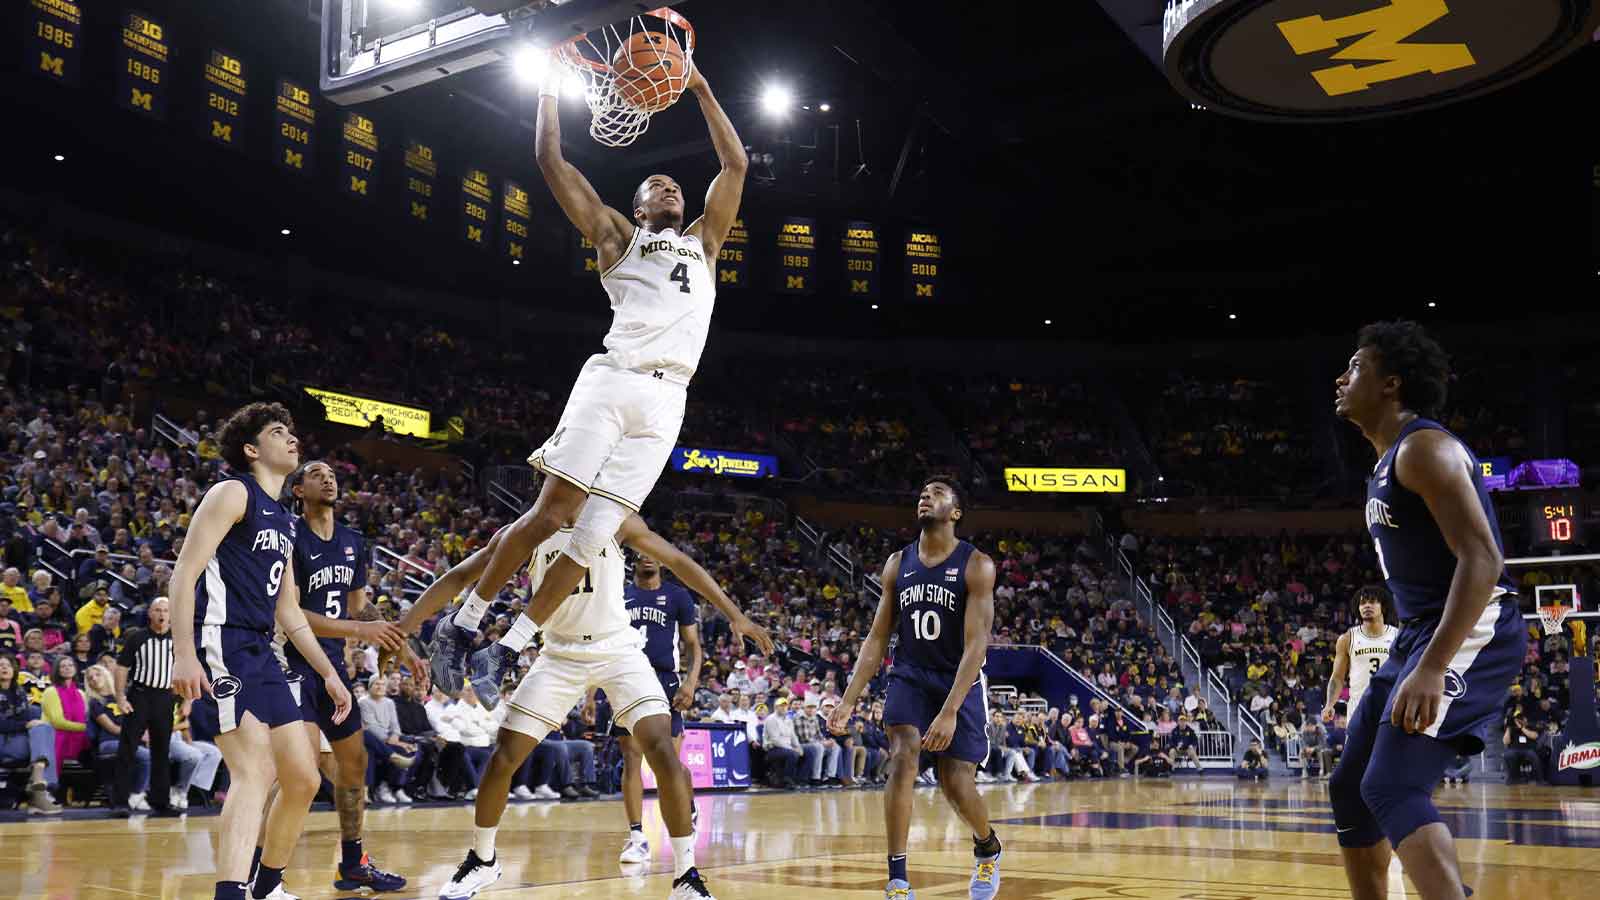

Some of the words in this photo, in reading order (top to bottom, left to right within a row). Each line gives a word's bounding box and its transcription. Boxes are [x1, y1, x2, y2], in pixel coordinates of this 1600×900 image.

[38, 22, 73, 48] 1985
[1276, 0, 1476, 96] M
[41, 52, 64, 77] M
[128, 59, 160, 84] 1986
[132, 88, 153, 111] M
[209, 93, 238, 116] 2012
[212, 120, 232, 142] M
[281, 123, 308, 144] 2014
[286, 149, 303, 168] M
[347, 151, 373, 171] 2017
[351, 176, 367, 195] M
[783, 224, 810, 234] NCAA
[847, 229, 873, 239] NCAA
[911, 233, 937, 243] NCAA
[784, 255, 808, 267] 1989
[848, 259, 872, 271] 2013
[912, 264, 937, 276] 2018
[670, 262, 691, 293] 4
[720, 270, 737, 282] M
[786, 275, 804, 288] M
[852, 279, 869, 292] M
[916, 283, 934, 297] M
[366, 402, 379, 411] OF
[382, 406, 428, 421] MICHIGAN
[382, 417, 405, 427] NION
[1011, 474, 1118, 487] NISSAN
[1544, 505, 1573, 519] 5:41
[1551, 518, 1571, 541] 10
[252, 528, 279, 552] PENN
[267, 560, 284, 596] 9
[308, 566, 333, 593] PENN
[325, 590, 341, 619] 5
[900, 583, 925, 611] PENN
[926, 584, 956, 612] STATE
[629, 607, 641, 621] NN
[642, 606, 667, 627] STATE
[910, 610, 941, 641] 10
[1355, 647, 1389, 656] MICHIGA
[1369, 657, 1380, 676] 3
[712, 742, 726, 758] 16
